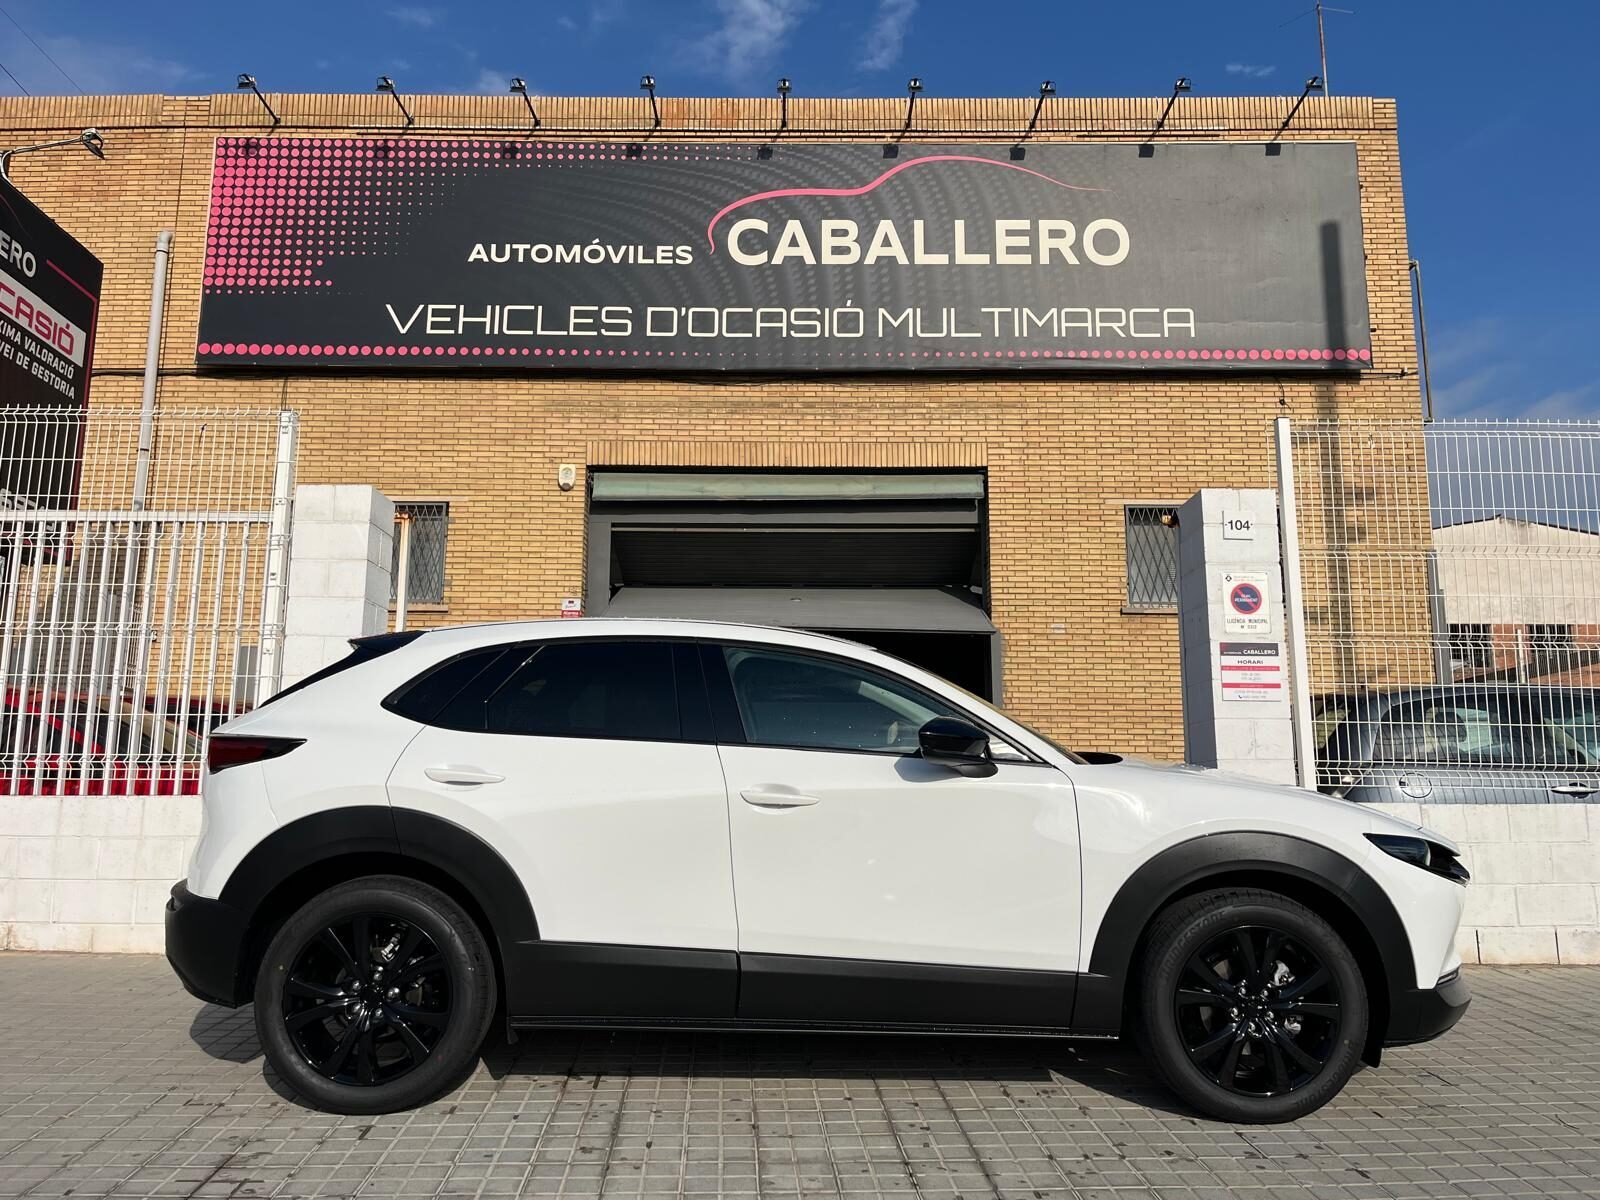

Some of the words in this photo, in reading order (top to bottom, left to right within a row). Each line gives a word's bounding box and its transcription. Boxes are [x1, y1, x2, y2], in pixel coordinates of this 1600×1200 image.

[467, 237, 694, 265] AUTOMÓVILES
[726, 218, 1131, 267] CABALLERO
[385, 303, 633, 337] VEHICLES
[645, 298, 865, 339] D'OCASIÓ
[878, 306, 1196, 339] MULTIMARCA
[16, 352, 31, 371] DE
[31, 361, 76, 400] GESTORIA
[24, 336, 75, 380] VALORACIÓ
[1227, 519, 1251, 531] 104
